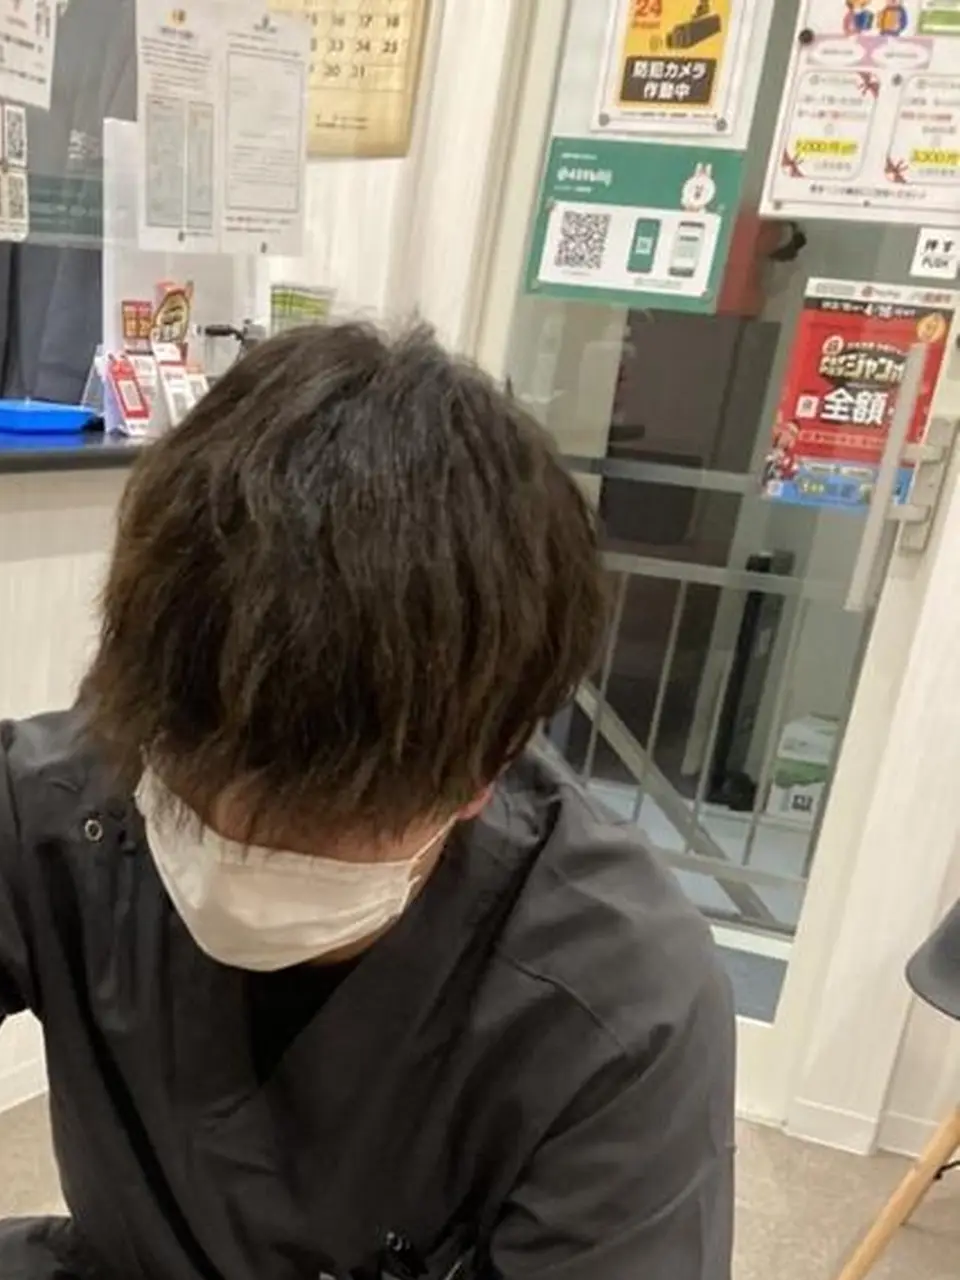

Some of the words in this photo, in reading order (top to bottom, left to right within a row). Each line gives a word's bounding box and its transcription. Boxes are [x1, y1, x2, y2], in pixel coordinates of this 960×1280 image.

[631, 60, 708, 79] 防犯カメラ
[643, 81, 692, 100] 作動中
[819, 386, 889, 426] 全額
